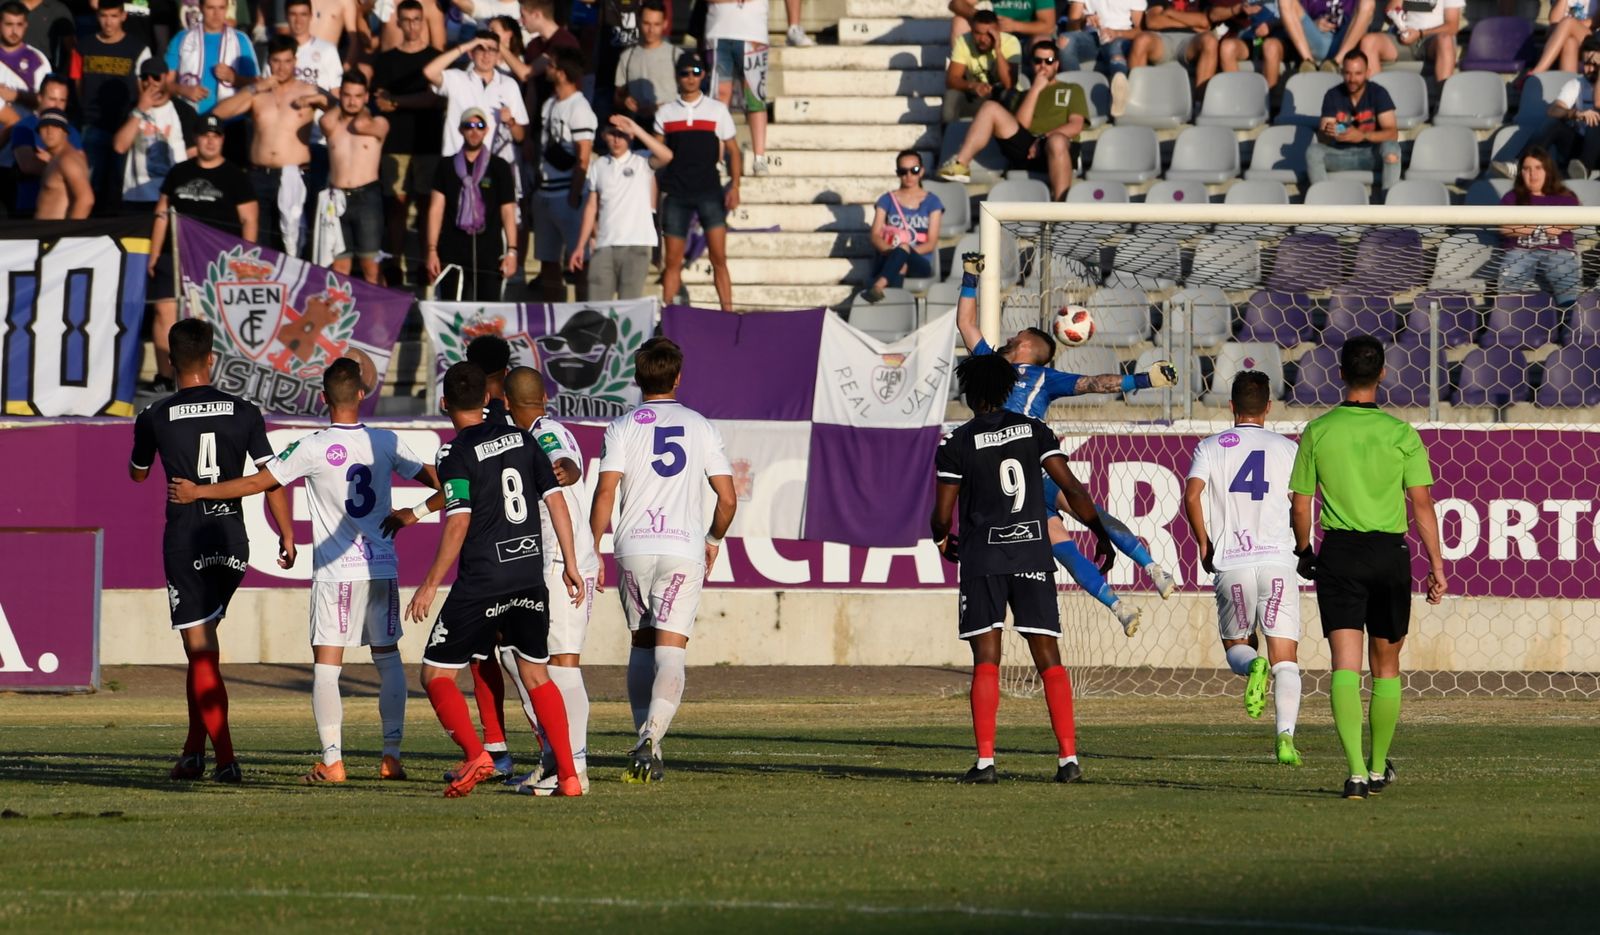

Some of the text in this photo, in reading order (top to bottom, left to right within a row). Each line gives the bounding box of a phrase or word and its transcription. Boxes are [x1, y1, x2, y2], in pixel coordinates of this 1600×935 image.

[223, 287, 281, 306] JAEN
[180, 402, 232, 415] STOP-FLUID
[902, 357, 950, 416] JAEN
[197, 432, 220, 485] 4
[651, 426, 687, 478] 5
[983, 425, 1030, 443] STOP-FLUID
[345, 463, 377, 519] 3
[445, 483, 454, 498] C
[501, 468, 528, 524] 8
[1000, 458, 1026, 513] 9
[1229, 450, 1269, 501] 4
[1433, 498, 1600, 561] ORT
